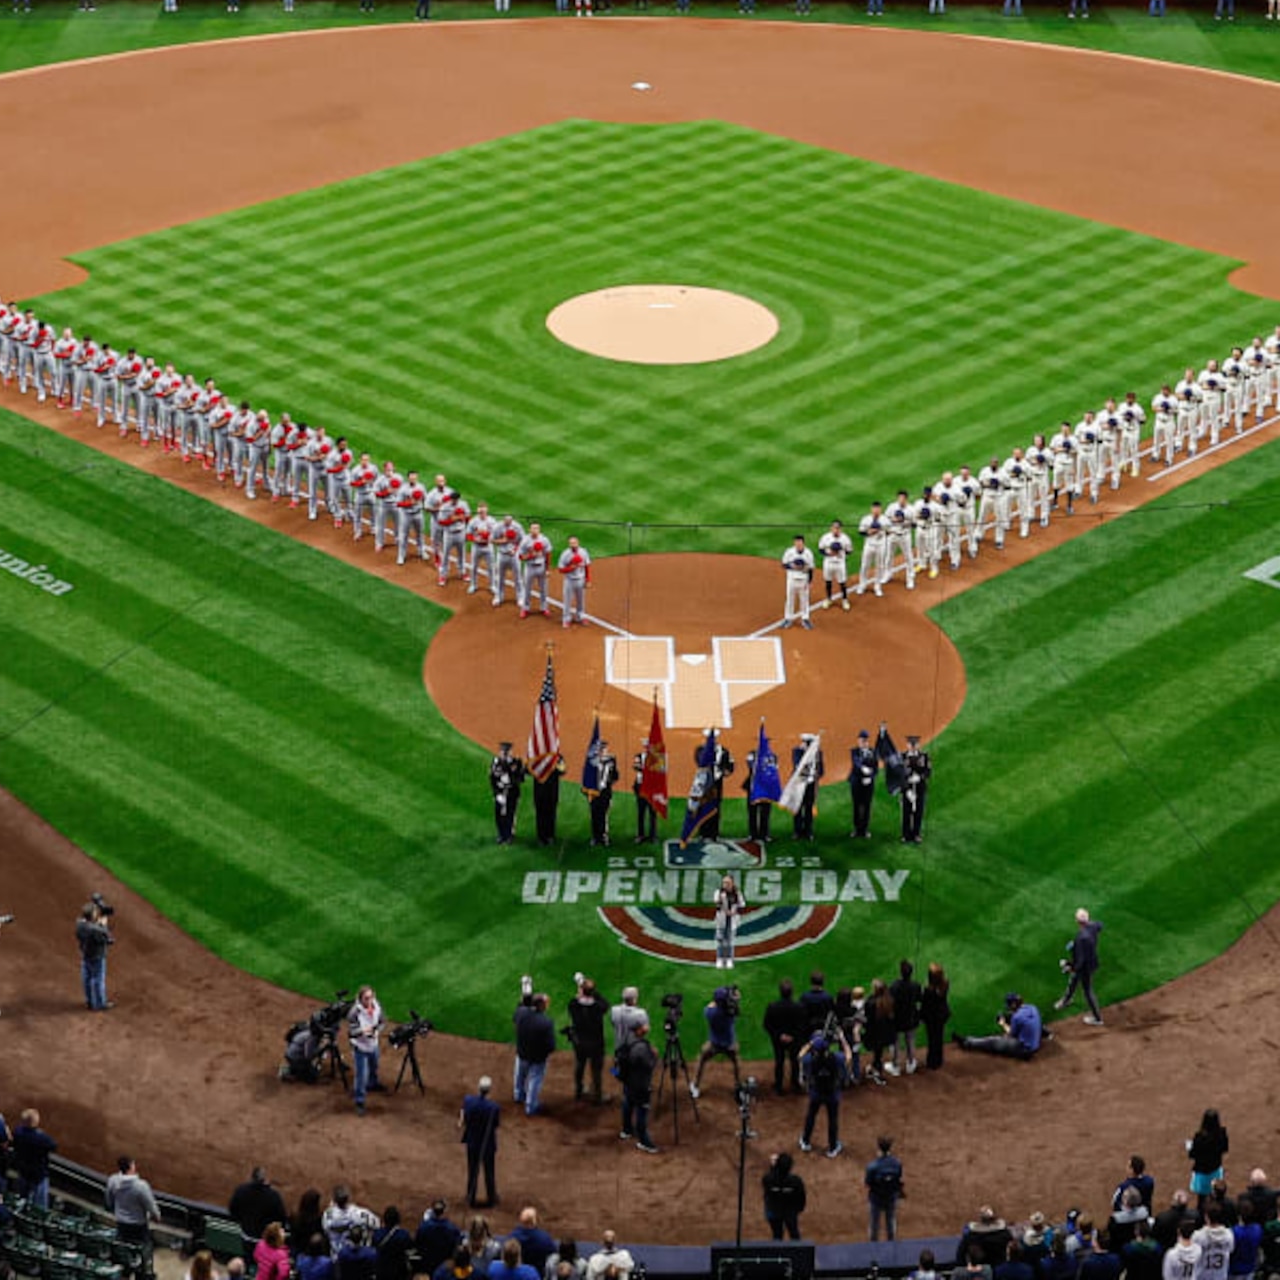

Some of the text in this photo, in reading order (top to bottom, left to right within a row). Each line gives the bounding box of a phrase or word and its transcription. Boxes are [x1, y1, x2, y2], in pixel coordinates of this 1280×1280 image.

[606, 855, 821, 868] 20 22
[800, 868, 910, 903] DAY
